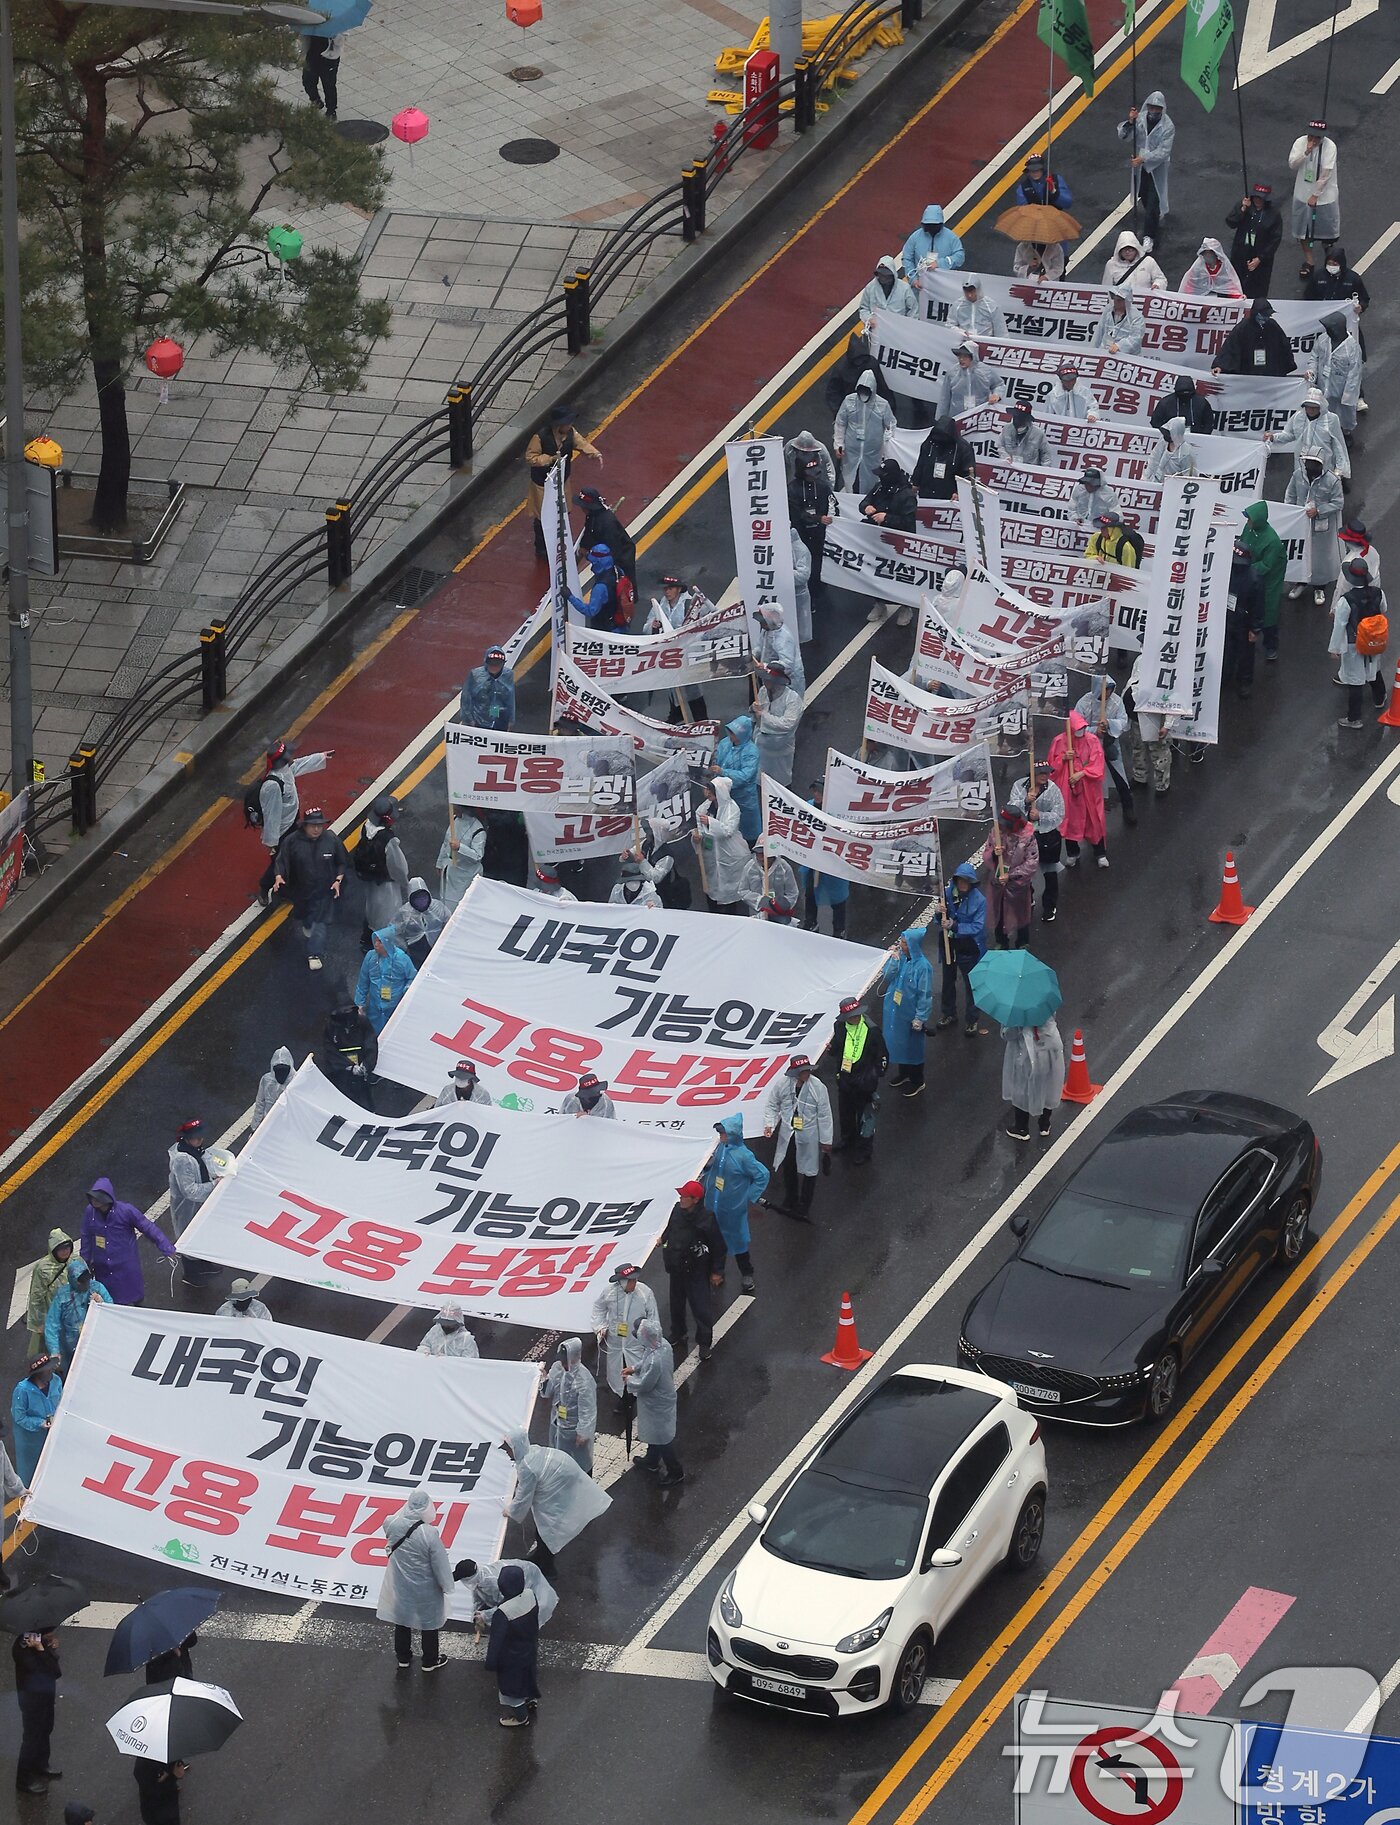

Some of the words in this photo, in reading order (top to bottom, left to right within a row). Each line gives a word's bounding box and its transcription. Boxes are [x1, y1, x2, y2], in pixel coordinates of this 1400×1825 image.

[1148, 300, 1201, 323] 일하고
[1206, 307, 1245, 325] 싶다
[1141, 323, 1188, 352] 고용
[983, 345, 1098, 374] 건설노동자도
[1102, 359, 1157, 389] 일하고
[1090, 384, 1140, 416] 고용
[1067, 428, 1124, 451] 일하고
[1013, 559, 1070, 584] 일하고
[1073, 568, 1111, 590] 싶다
[572, 641, 604, 656] 건설
[572, 656, 627, 678] 불법
[632, 647, 684, 675] 고용
[866, 695, 920, 735] 불법
[445, 731, 488, 748] 내국인
[490, 742, 547, 756] 기능인력
[473, 754, 565, 794] 고용
[558, 774, 633, 806] 보장!
[768, 794, 795, 816] 건설
[767, 810, 816, 850] 불법
[822, 835, 873, 871] 고용
[875, 849, 936, 877] 근절!
[497, 913, 680, 983] 내국인
[595, 985, 826, 1051] 기능인력
[430, 997, 604, 1092] 고용
[605, 1047, 791, 1108] 보장!
[316, 1114, 501, 1181] 내국인
[415, 1182, 655, 1240] 기능인력
[244, 1189, 423, 1282] 고용
[417, 1241, 620, 1299] 보장!
[131, 1332, 324, 1407] 내국인
[1037, 1388, 1059, 1400] 7769
[247, 1410, 493, 1493] 기능인력
[81, 1434, 260, 1537] 고용
[210, 1554, 369, 1600] 전국건설노동조합
[777, 1684, 801, 1697] 6849
[115, 1728, 149, 1754] maruman
[1256, 1764, 1377, 1805] 청계2가
[1256, 1800, 1327, 1825] 방향
